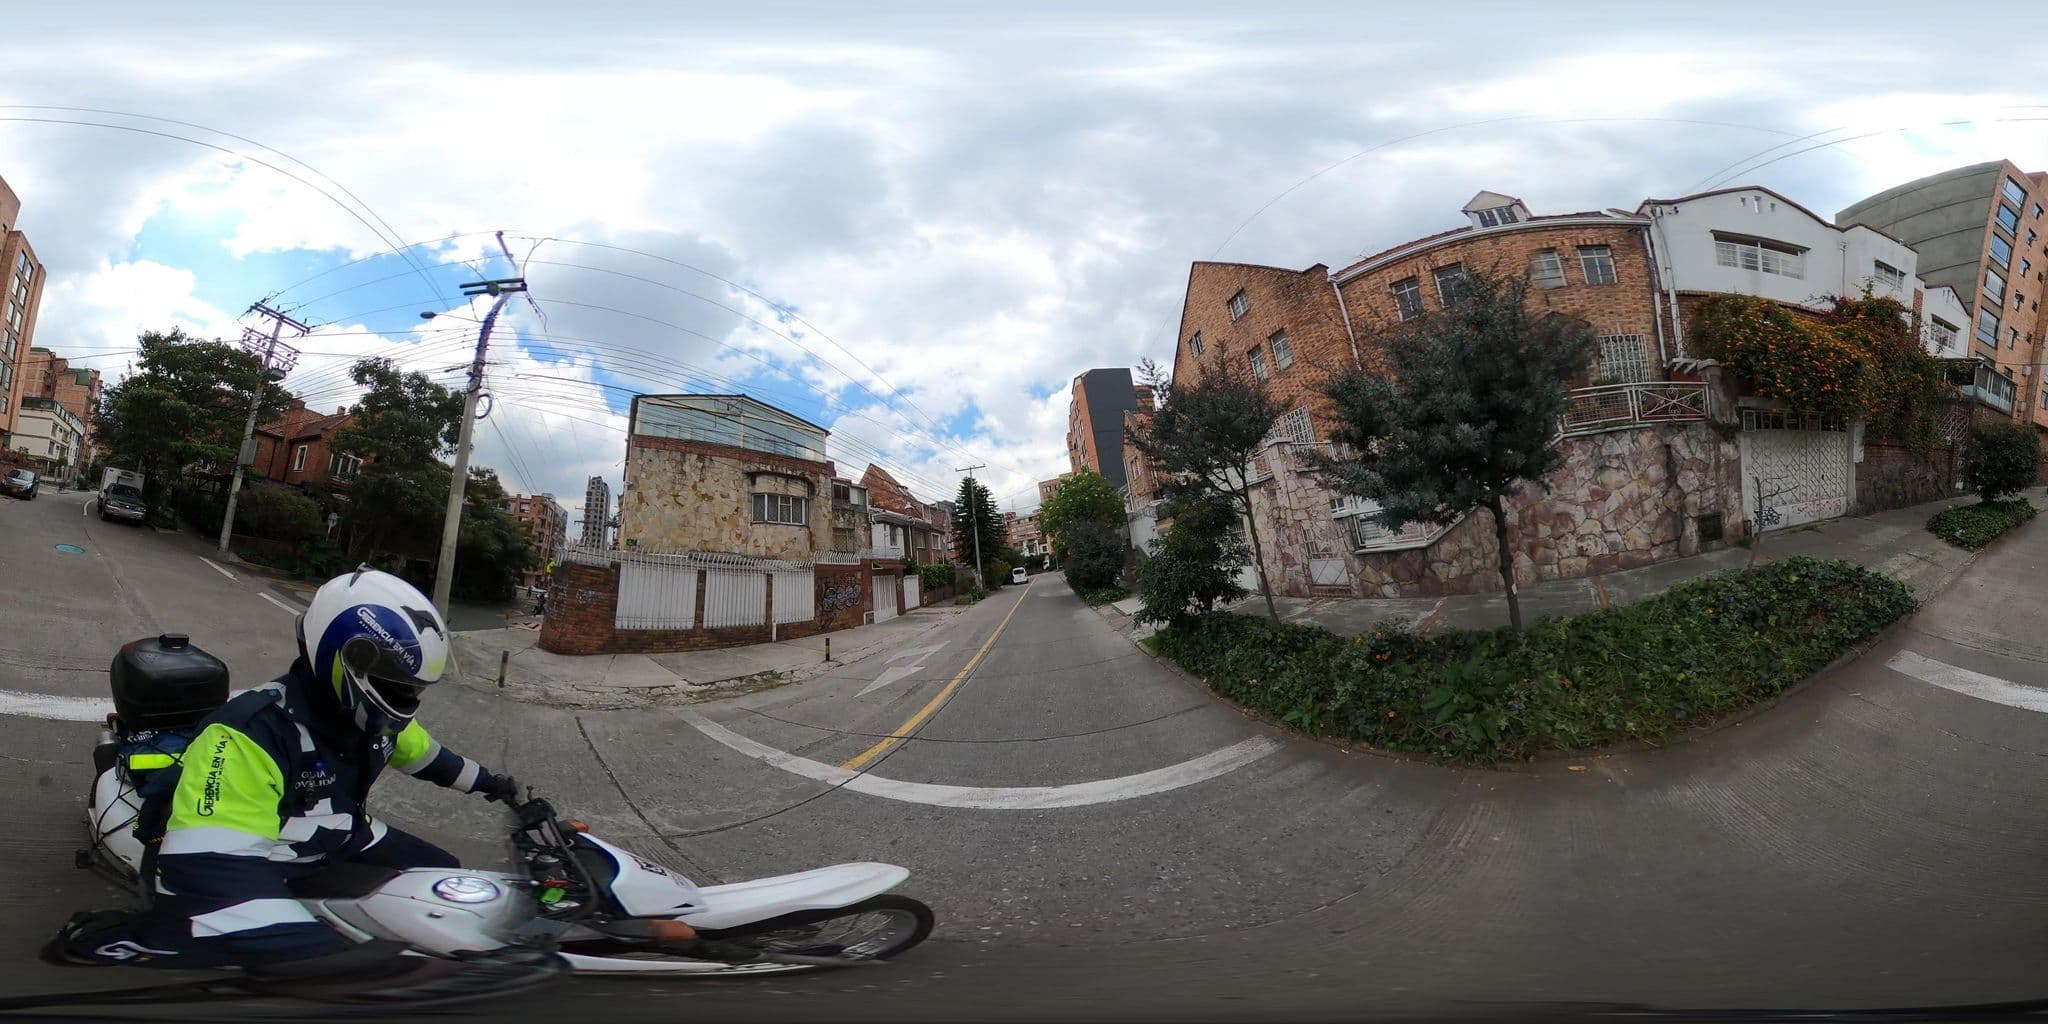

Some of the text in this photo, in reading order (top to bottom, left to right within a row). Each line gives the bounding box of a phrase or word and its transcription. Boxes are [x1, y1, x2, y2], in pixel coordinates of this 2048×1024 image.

[357, 607, 394, 645] GERENCIA
[393, 642, 405, 655] EN
[197, 770, 217, 817] GERENCIA
[211, 756, 221, 769] EN
